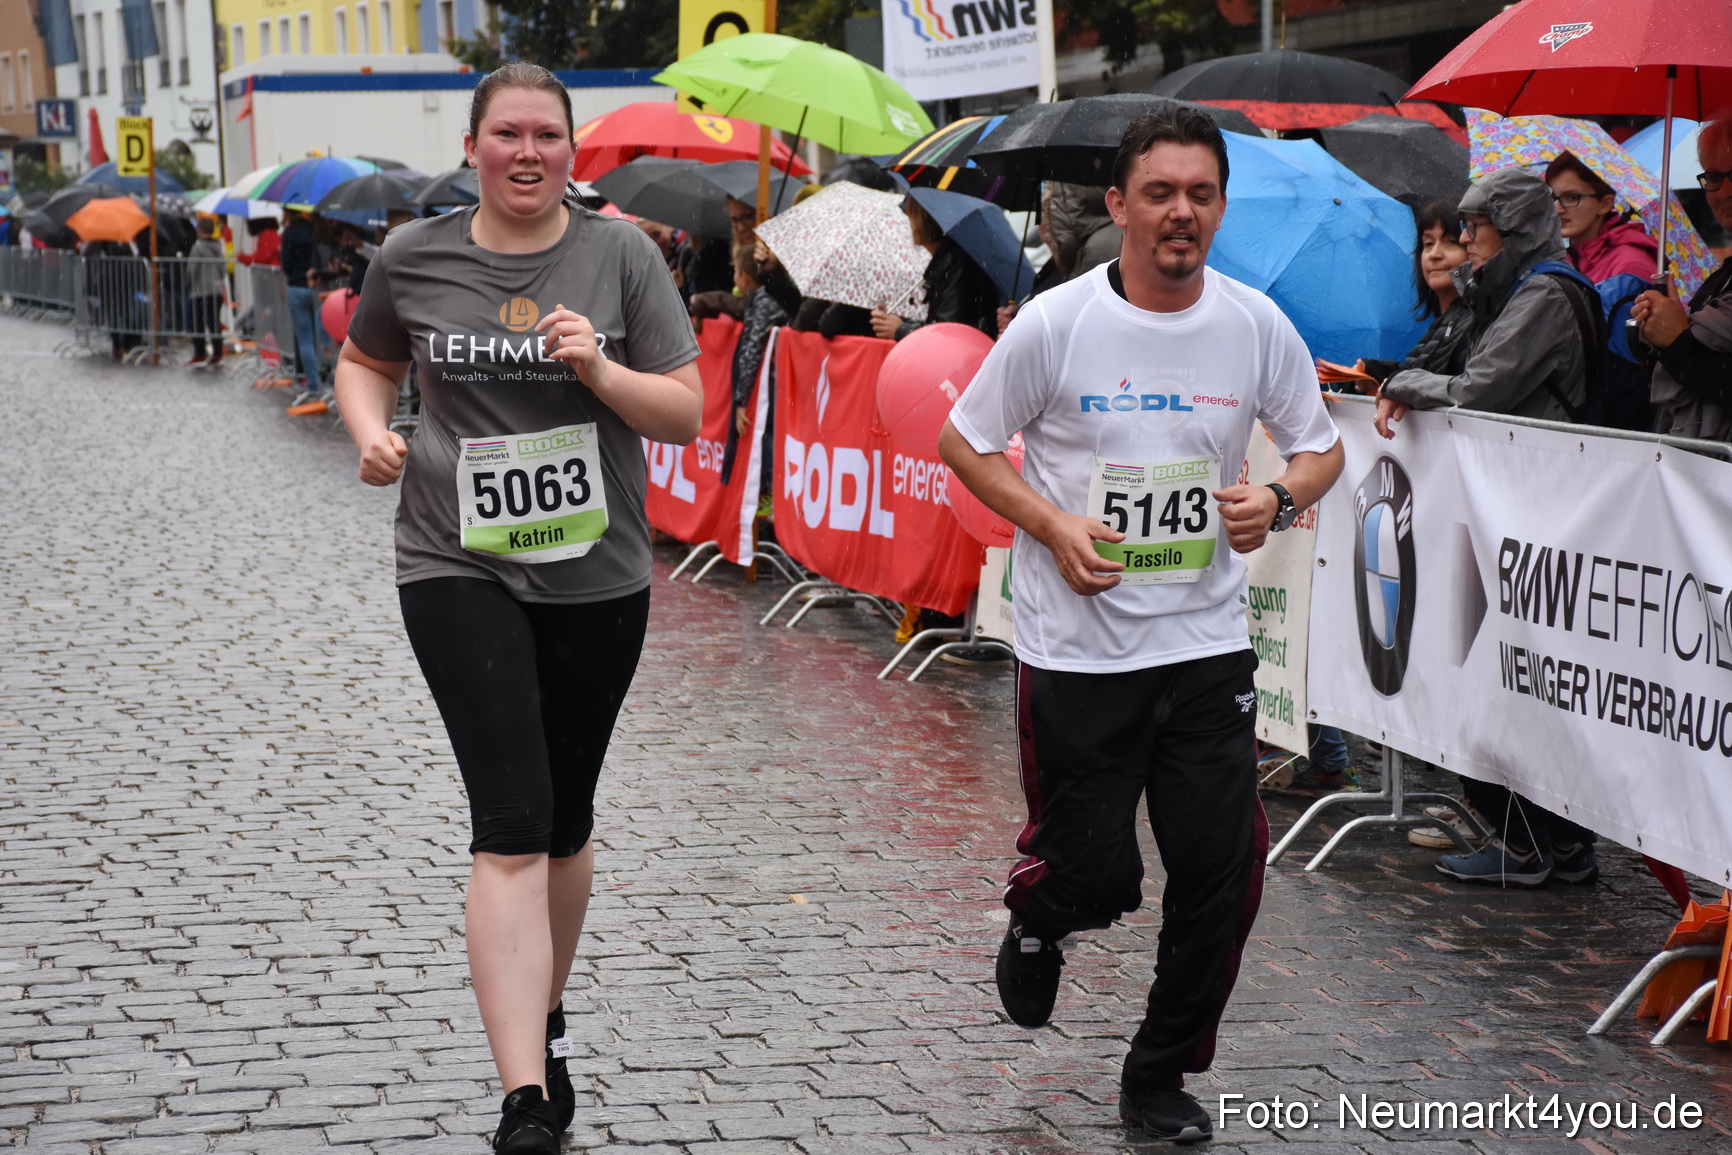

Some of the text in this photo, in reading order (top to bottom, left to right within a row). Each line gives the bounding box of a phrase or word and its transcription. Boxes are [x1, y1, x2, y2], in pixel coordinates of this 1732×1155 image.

[126, 135, 144, 162] D
[429, 332, 607, 364] LEHMER
[441, 370, 581, 382] Anwalts- und Steuerka
[517, 430, 585, 455] BOCK
[696, 436, 725, 473] ene
[465, 452, 510, 462] NeuerMarkt
[1153, 460, 1209, 480] BOCK
[473, 458, 591, 519] 5063
[1101, 473, 1145, 484] NeuerMarkt
[467, 516, 473, 526] S
[1102, 487, 1208, 537] 5143
[509, 526, 564, 549] Katrin
[1123, 548, 1182, 568] Tassilo
[1499, 537, 1584, 632] BMW
[1248, 585, 1287, 624] gung
[1249, 628, 1287, 668] rdienst
[1500, 641, 1590, 716] WENIGER
